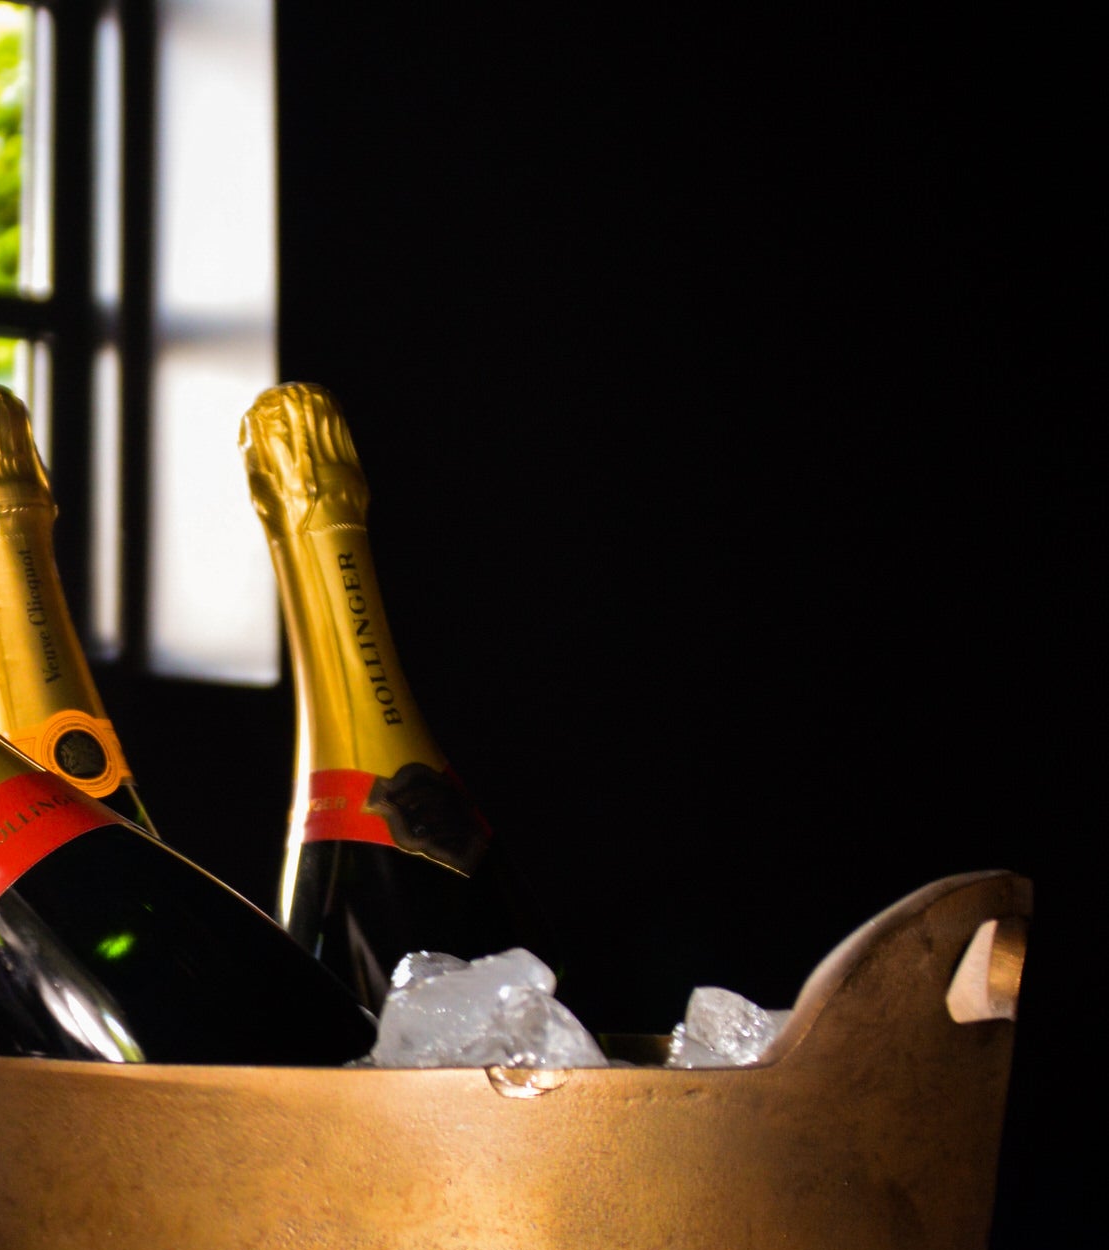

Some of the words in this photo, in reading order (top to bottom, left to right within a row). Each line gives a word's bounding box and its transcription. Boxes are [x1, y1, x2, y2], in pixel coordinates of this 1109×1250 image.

[17, 549, 48, 627] Clicquot
[42, 630, 64, 685] Veuve
[337, 551, 404, 727] BOLLINGER
